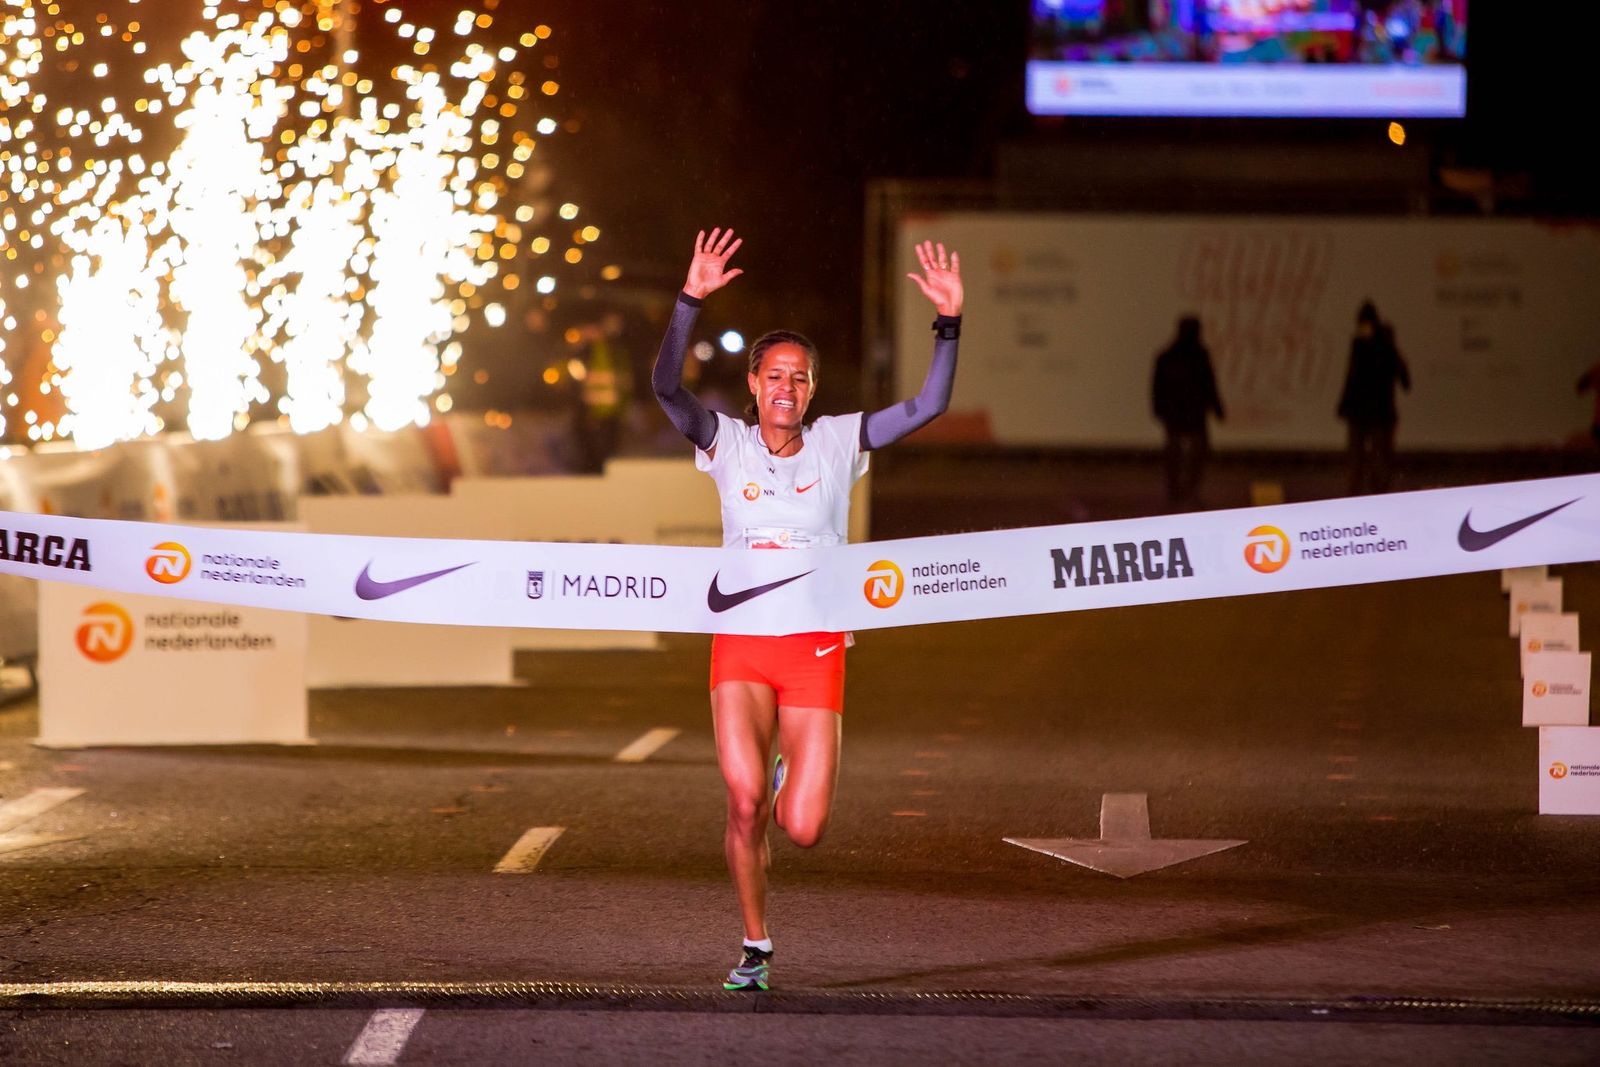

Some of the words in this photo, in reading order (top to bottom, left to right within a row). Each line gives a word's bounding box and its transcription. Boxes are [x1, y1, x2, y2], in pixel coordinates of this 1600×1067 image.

[1301, 522, 1378, 543] nationale
[1301, 536, 1408, 560] nederlanden
[202, 552, 280, 570] nationale
[912, 558, 981, 578] nationale
[1050, 537, 1194, 589] MARCA
[200, 566, 306, 588] nederlanden
[562, 574, 667, 599] MADRID
[913, 575, 1007, 596] nederlanden
[146, 612, 240, 628] nationale
[146, 634, 275, 650] nederlanden
